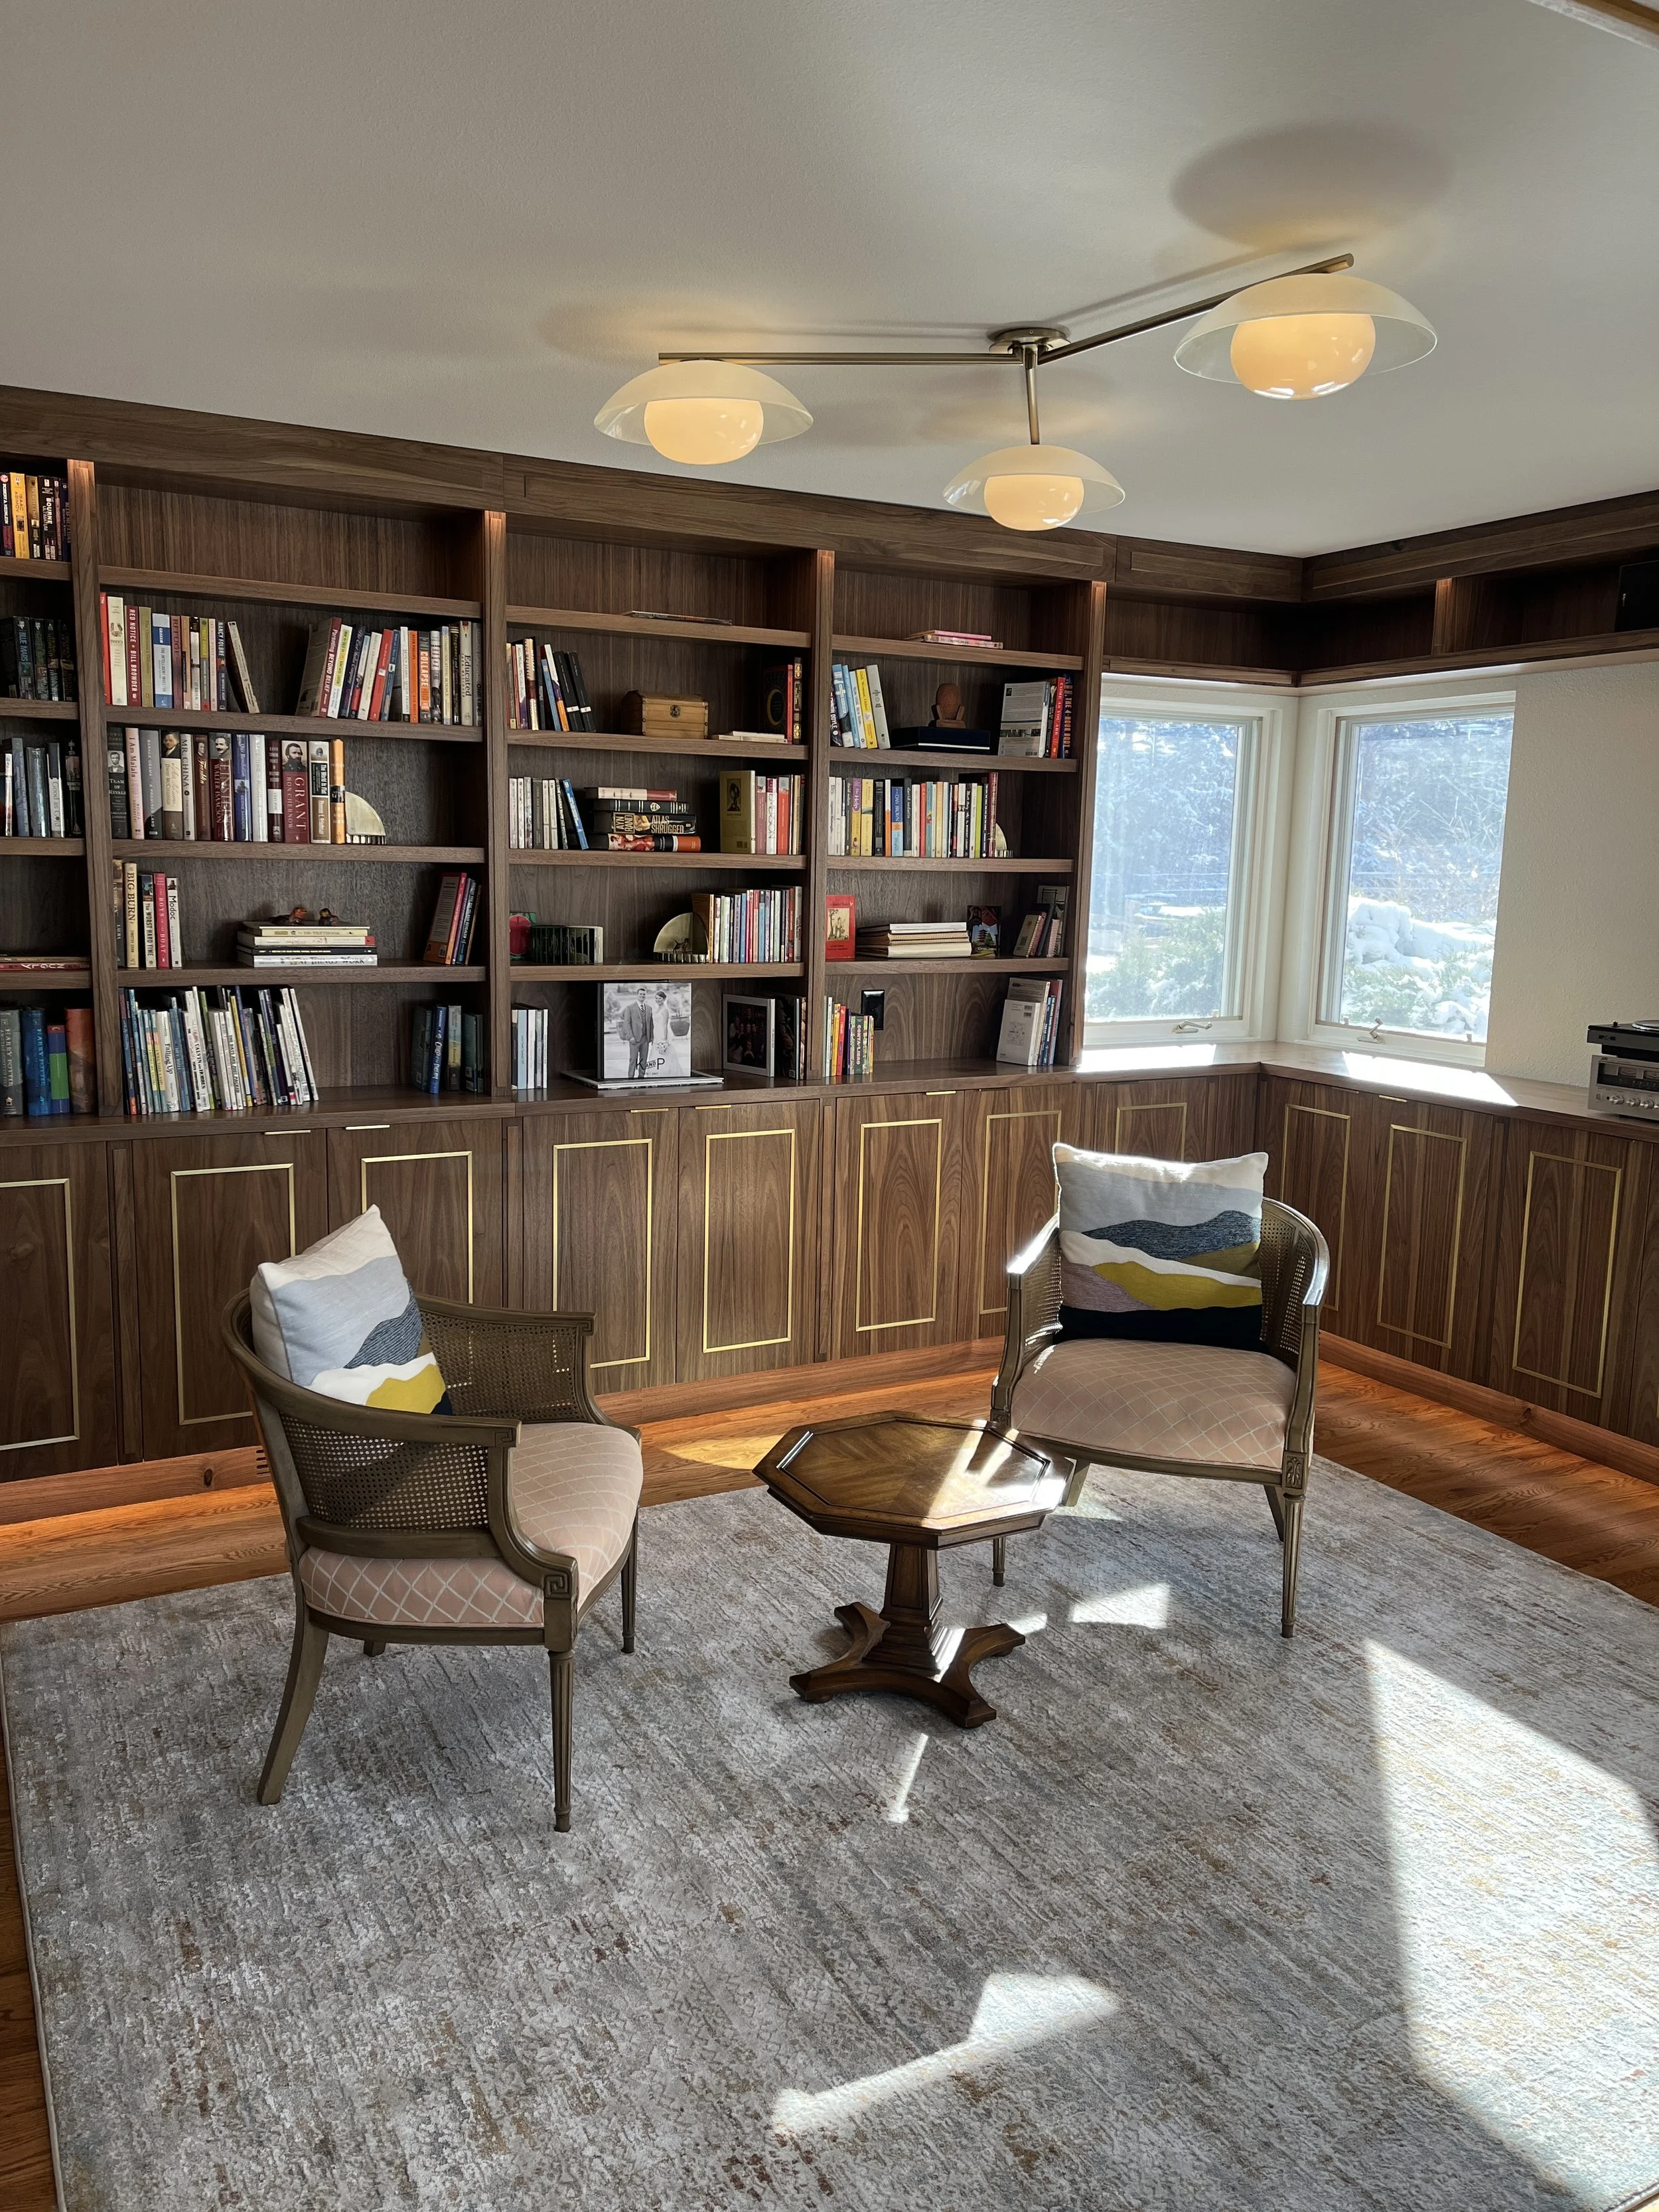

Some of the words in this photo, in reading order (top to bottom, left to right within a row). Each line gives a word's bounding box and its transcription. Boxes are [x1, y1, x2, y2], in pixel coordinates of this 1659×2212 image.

[328, 629, 338, 652] Parenting
[326, 653, 335, 674] BEYOND
[129, 743, 135, 753] Am
[198, 758, 207, 784] Franklin
[294, 777, 306, 830] GRANT
[616, 816, 624, 830] AYN
[651, 816, 670, 824] ATLAS
[651, 824, 684, 833] SHRUGGED
[636, 1059, 644, 1070] K
[657, 1059, 665, 1070] P
